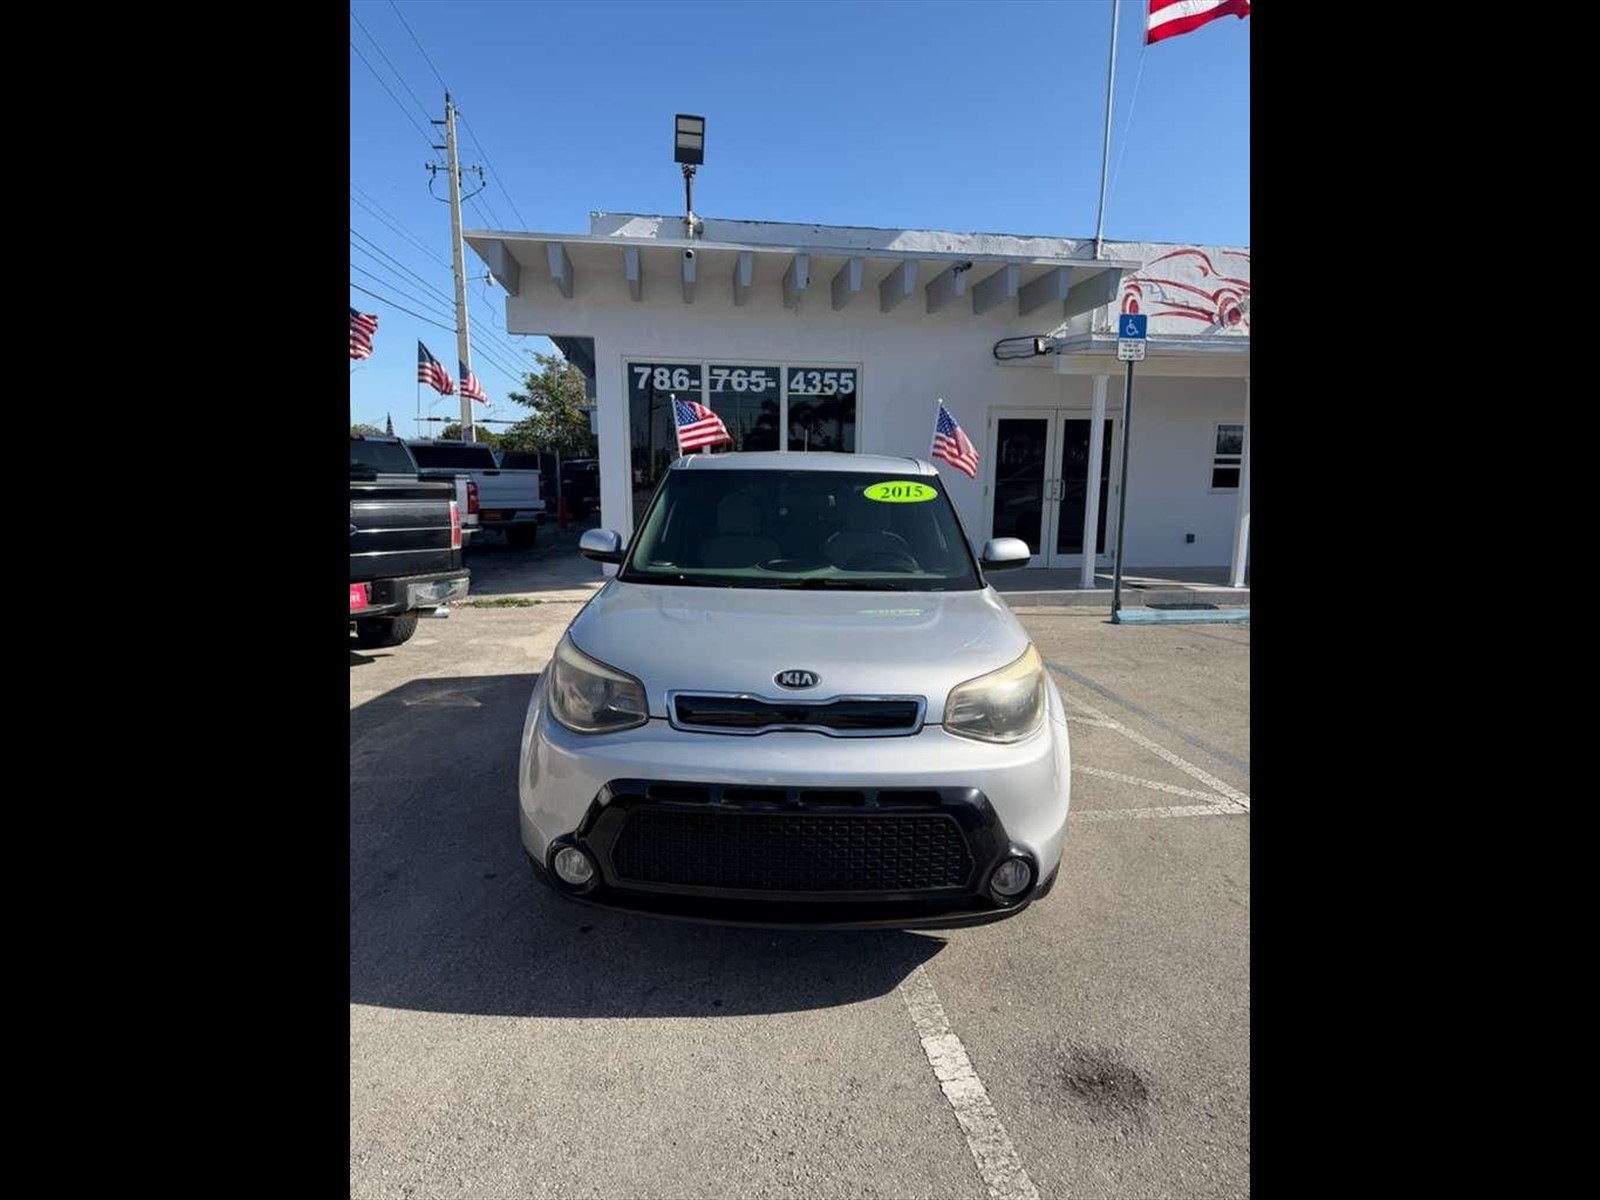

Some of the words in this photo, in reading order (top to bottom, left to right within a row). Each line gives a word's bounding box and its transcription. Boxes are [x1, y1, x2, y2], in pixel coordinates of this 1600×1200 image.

[633, 366, 700, 391] 786-
[711, 368, 776, 393] 765-
[790, 371, 855, 394] 4355
[880, 485, 923, 499] 2015
[781, 672, 814, 686] KIA
